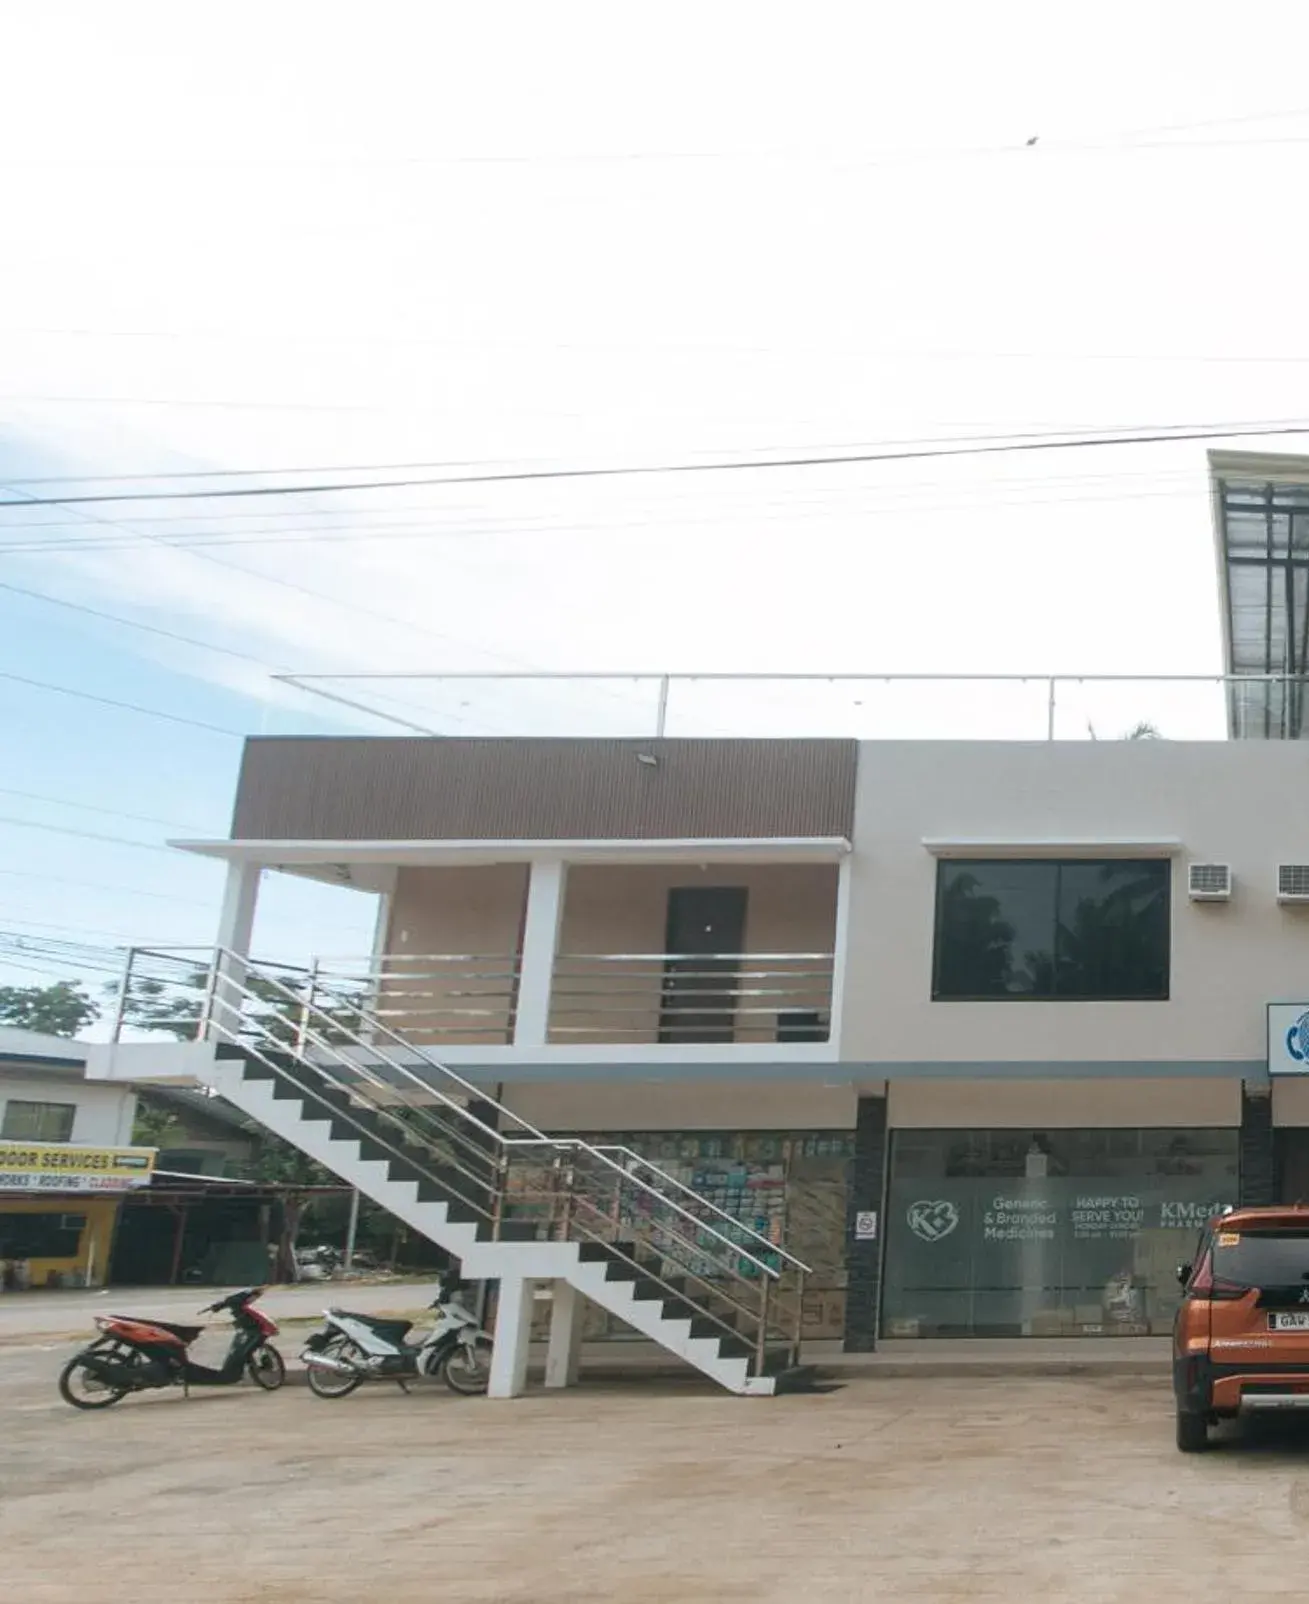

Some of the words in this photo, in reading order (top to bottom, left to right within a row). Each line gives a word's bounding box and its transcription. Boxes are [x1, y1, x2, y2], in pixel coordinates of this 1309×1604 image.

[42, 1152, 108, 1169] SERVICES
[39, 1175, 80, 1188] ROOFING
[993, 1197, 1048, 1210] Generic
[1076, 1197, 1119, 1209] HAPPY
[1121, 1197, 1139, 1209] TO
[1072, 1210, 1112, 1222] SERVE
[1114, 1209, 1144, 1222] YOU!
[1161, 1201, 1232, 1219] KMed
[984, 1212, 994, 1224] &
[997, 1212, 1056, 1225] Branded
[1160, 1219, 1204, 1228] PHARM
[984, 1227, 1054, 1239] Medicines
[1280, 1313, 1304, 1327] GAW
